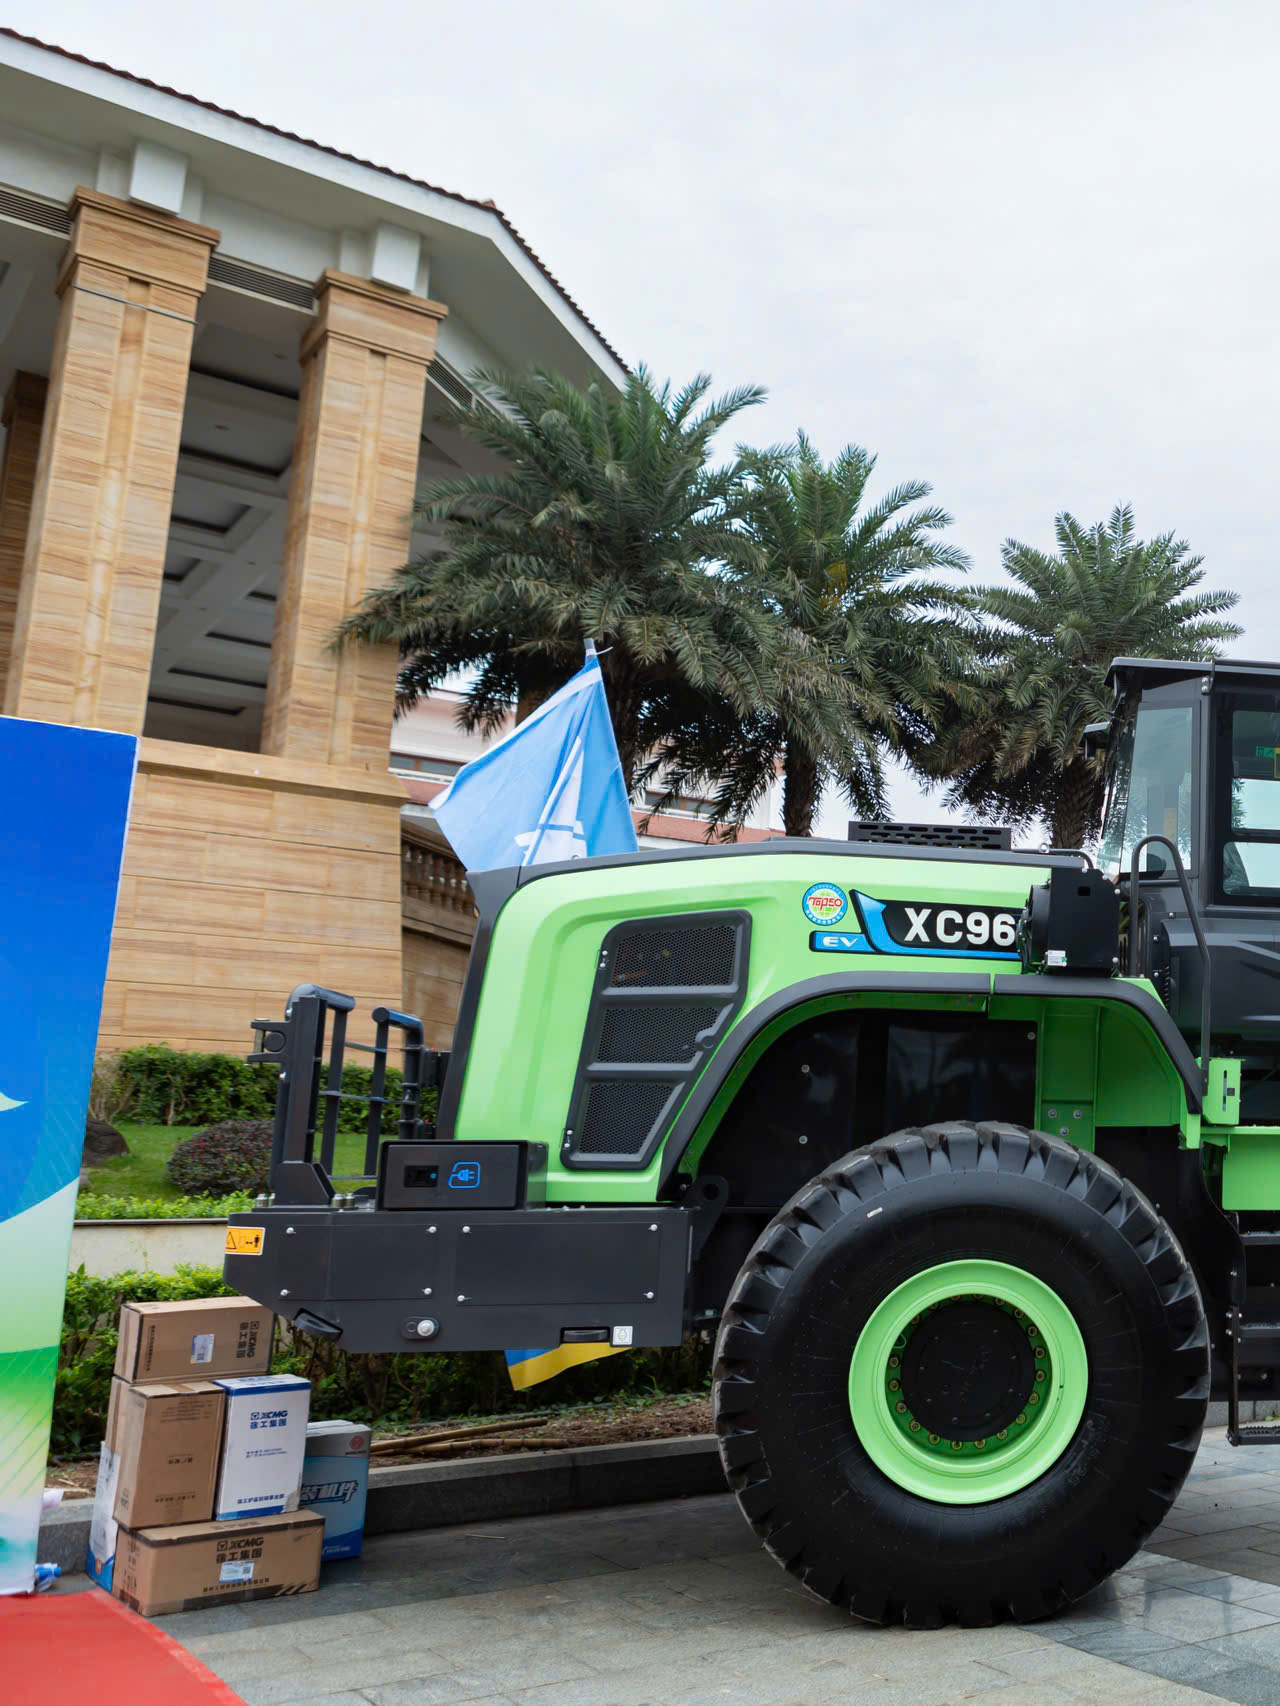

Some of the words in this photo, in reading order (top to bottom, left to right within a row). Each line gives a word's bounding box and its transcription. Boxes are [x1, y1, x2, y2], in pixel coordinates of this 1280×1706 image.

[822, 936, 858, 947] EV
[260, 1410, 288, 1419] XCMG
[228, 1536, 264, 1550] XCMG
